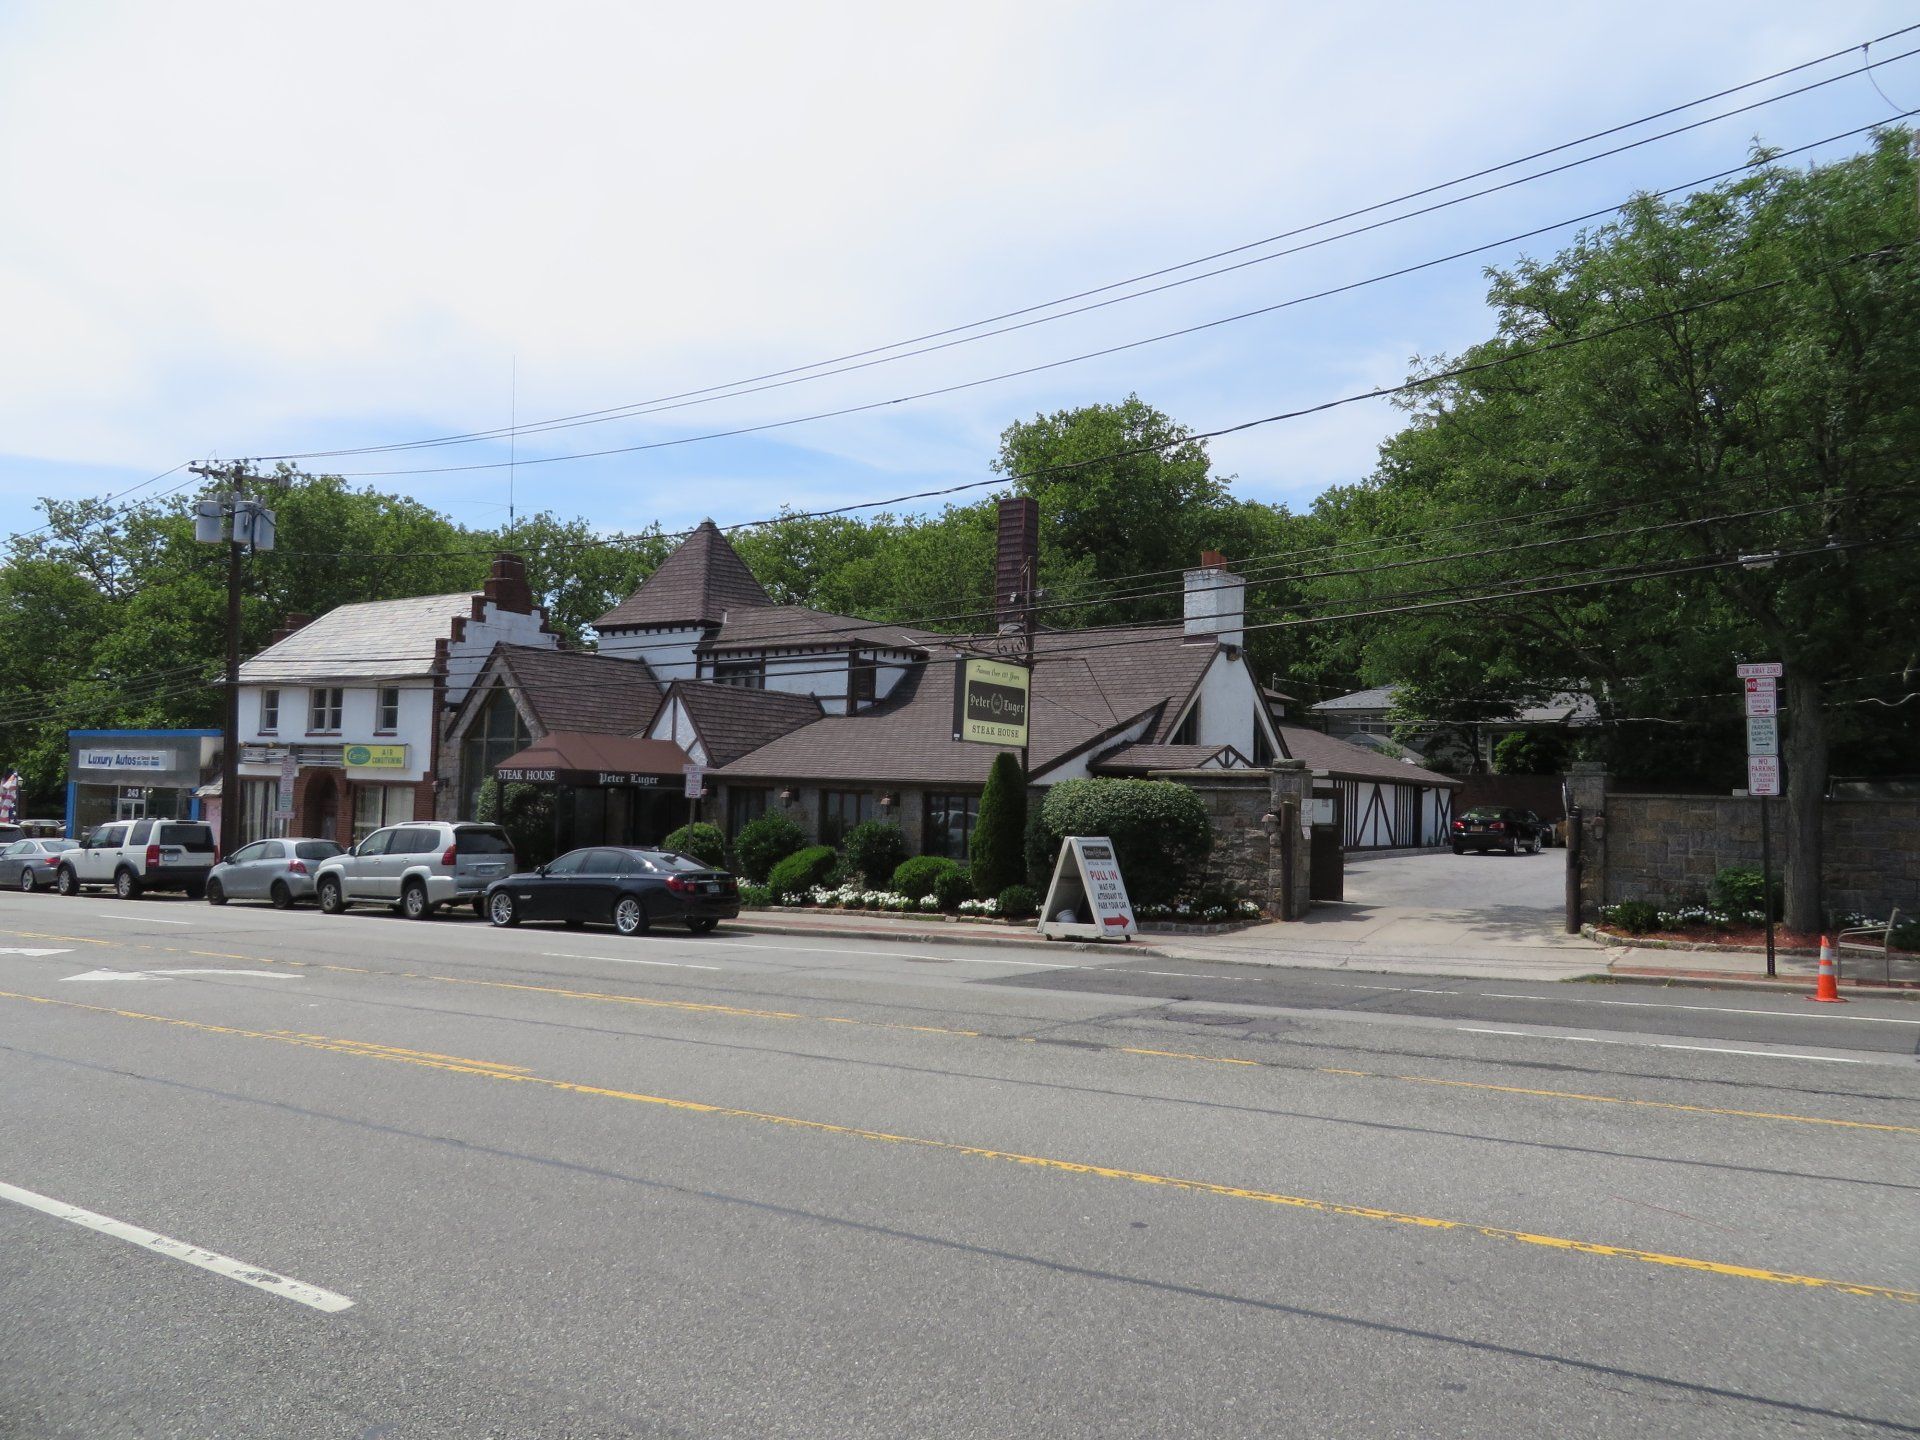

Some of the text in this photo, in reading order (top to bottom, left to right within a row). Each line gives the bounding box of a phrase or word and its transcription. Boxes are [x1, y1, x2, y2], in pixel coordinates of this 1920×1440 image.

[1739, 666, 1780, 675] TOW AWAY ZONE
[1747, 681, 1757, 690] NO
[969, 693, 991, 708] Peter
[1003, 699, 1025, 717] Luger
[972, 725, 1020, 738] STEAK HOUSE
[88, 753, 113, 767] Luxury
[115, 754, 136, 766] Autos
[498, 769, 556, 781] STEAK HOUSE
[599, 772, 659, 786] Peter Luger
[127, 788, 139, 798] 243
[1089, 870, 1118, 881] PULL IN
[1098, 883, 1117, 891] WAIT FOR
[1097, 892, 1117, 900] ATTENDANT
[1097, 901, 1127, 909] PARK YOUR CAR
